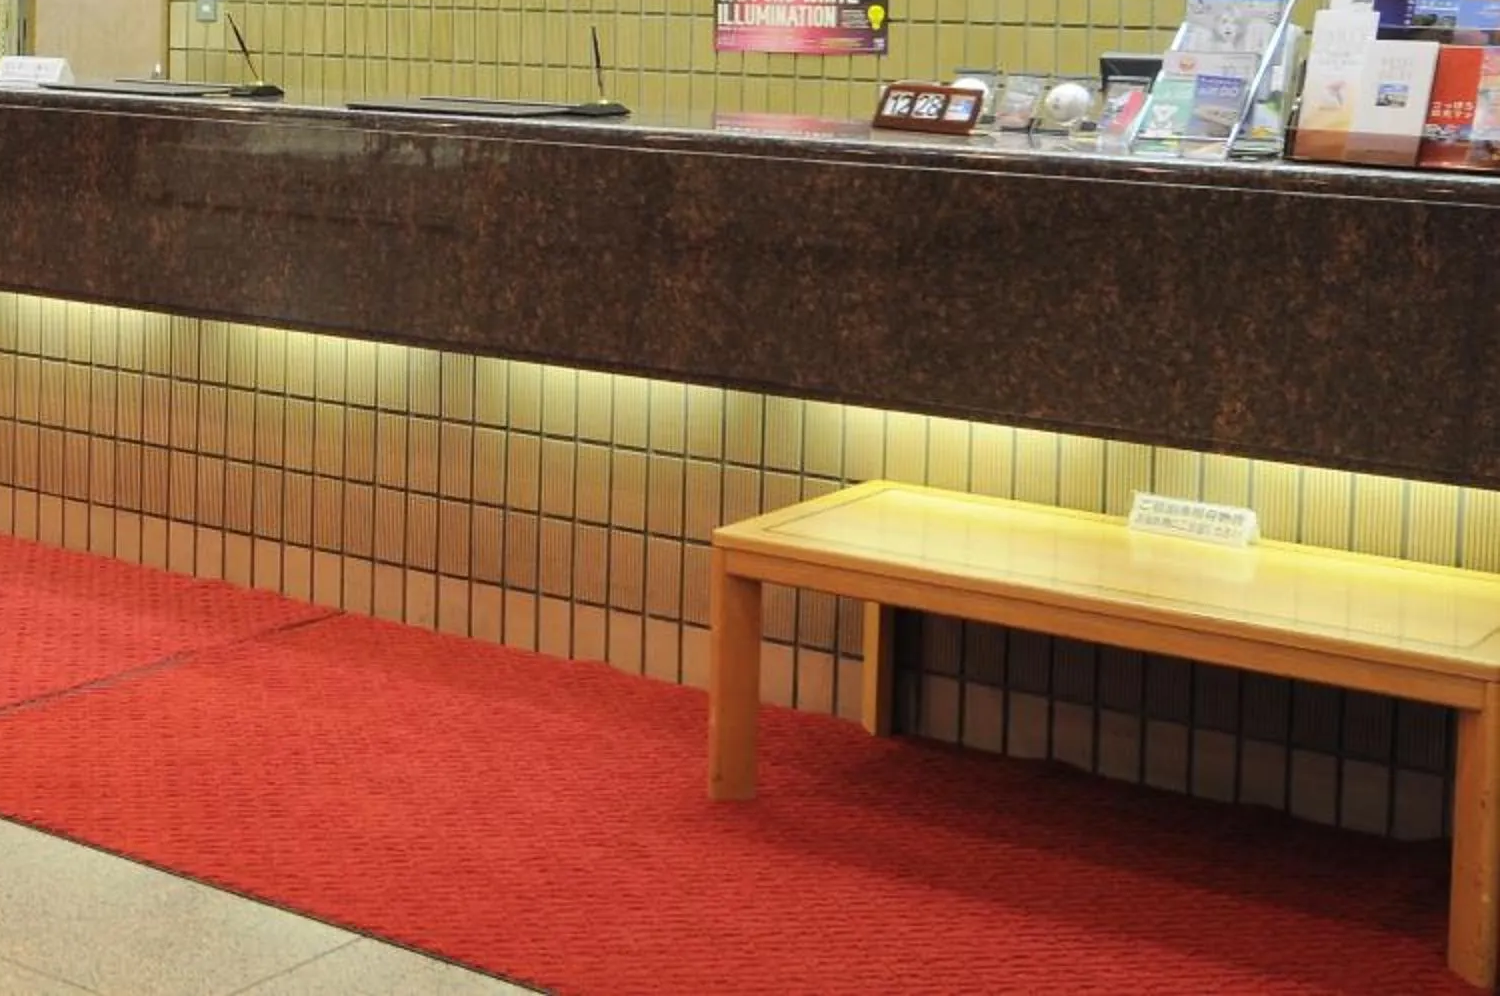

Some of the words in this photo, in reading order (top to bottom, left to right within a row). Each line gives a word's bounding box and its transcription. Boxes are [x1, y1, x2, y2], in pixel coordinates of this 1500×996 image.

[717, 3, 838, 27] ILLUMINATION
[891, 94, 913, 116] 12
[915, 94, 942, 117] 28
